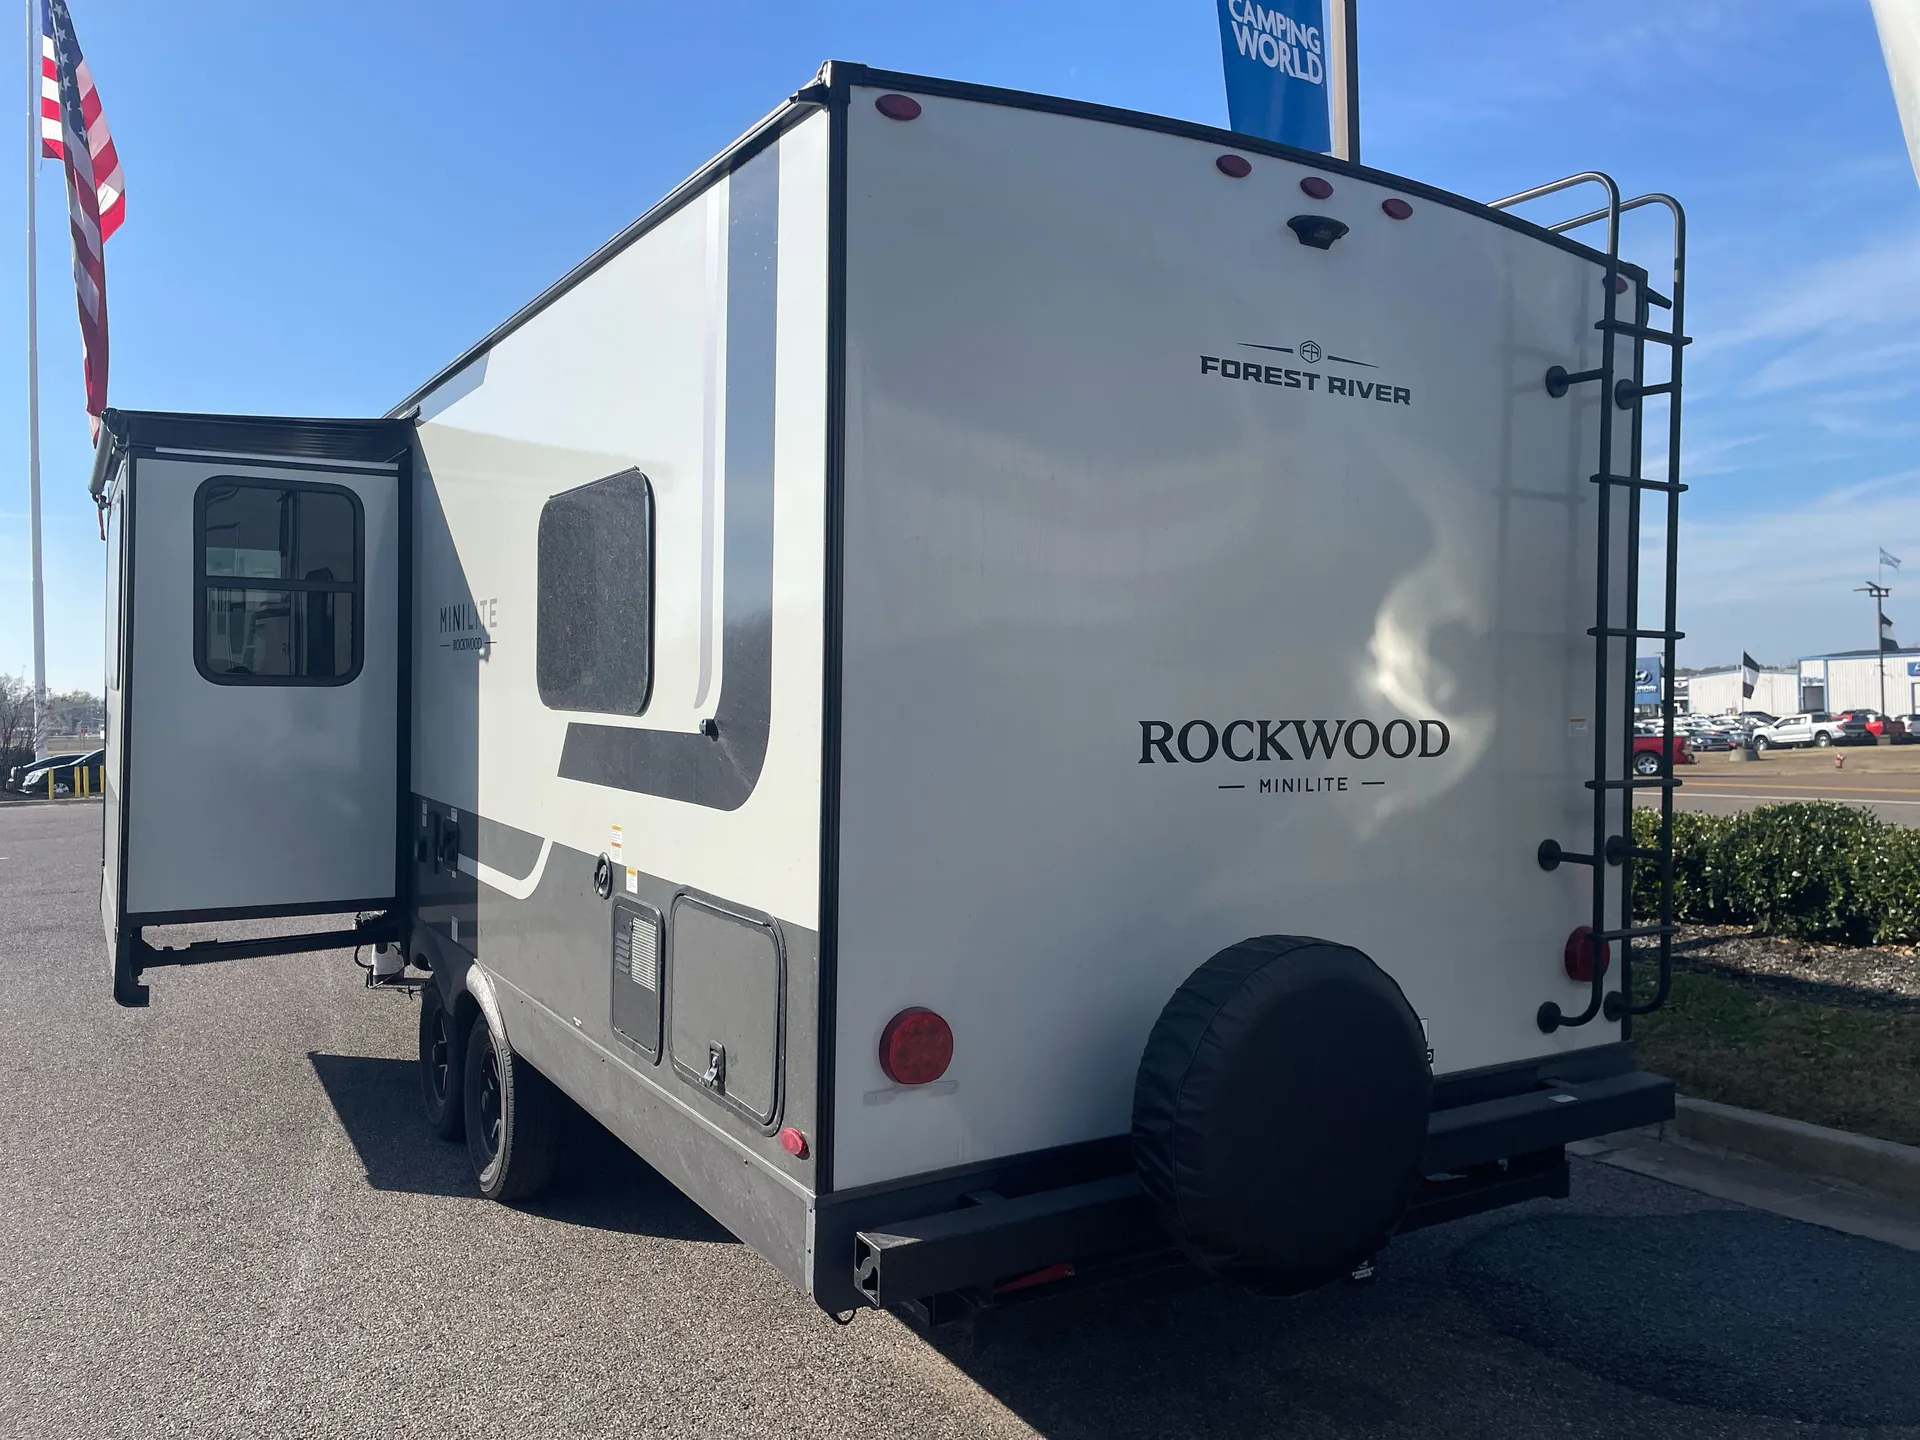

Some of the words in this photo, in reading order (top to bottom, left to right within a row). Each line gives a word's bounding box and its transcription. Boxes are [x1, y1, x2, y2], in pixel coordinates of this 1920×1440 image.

[1229, 0, 1321, 54] CAMPING
[1231, 21, 1323, 85] WORLD
[1200, 355, 1321, 391] FOREST
[1327, 375, 1411, 405] RIVER
[440, 598, 497, 633] MINILITE
[452, 637, 483, 651] ROCKWOOD
[1138, 719, 1450, 764] ROCKWOOD
[1259, 777, 1348, 793] MINILITE
